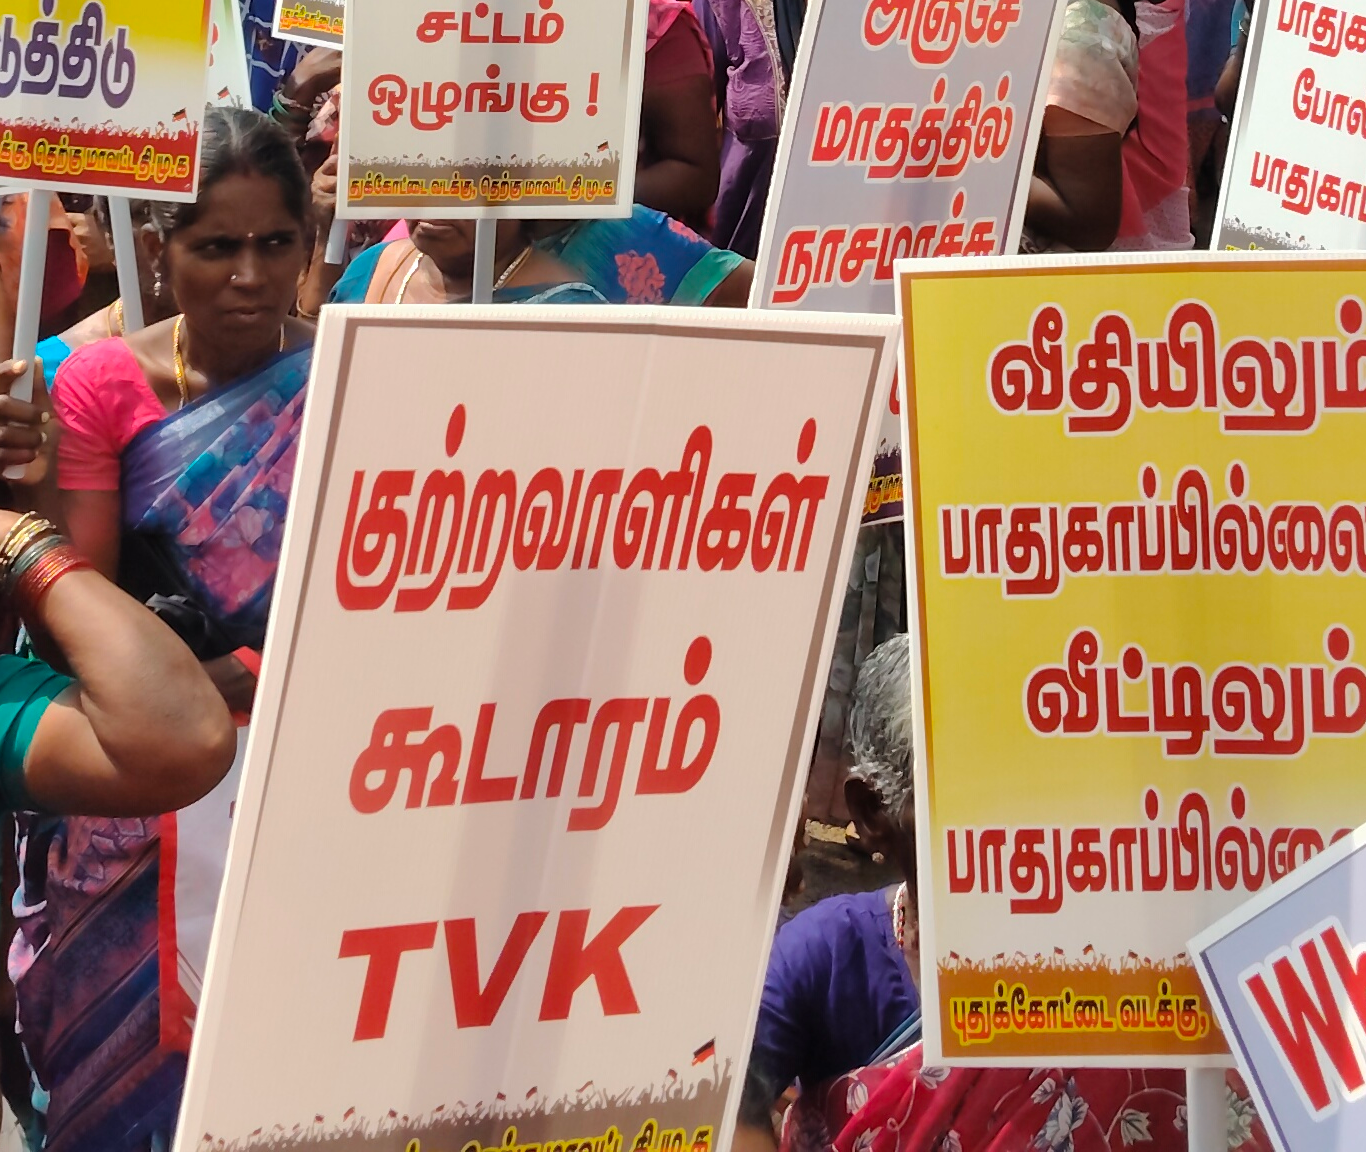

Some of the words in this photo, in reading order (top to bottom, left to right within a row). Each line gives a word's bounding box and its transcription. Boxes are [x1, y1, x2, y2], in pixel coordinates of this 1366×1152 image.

[367, 64, 570, 131] ஒழுங்கு
[584, 71, 601, 118] !
[812, 76, 1013, 179] மாதத்தில்
[569, 174, 614, 202] தி.மு.க
[335, 404, 830, 615] குற்றவாளிகள்
[348, 636, 722, 832] கூடாரம்
[337, 904, 662, 1043] TVK
[954, 980, 1115, 1046] புதுக்கோட்டை
